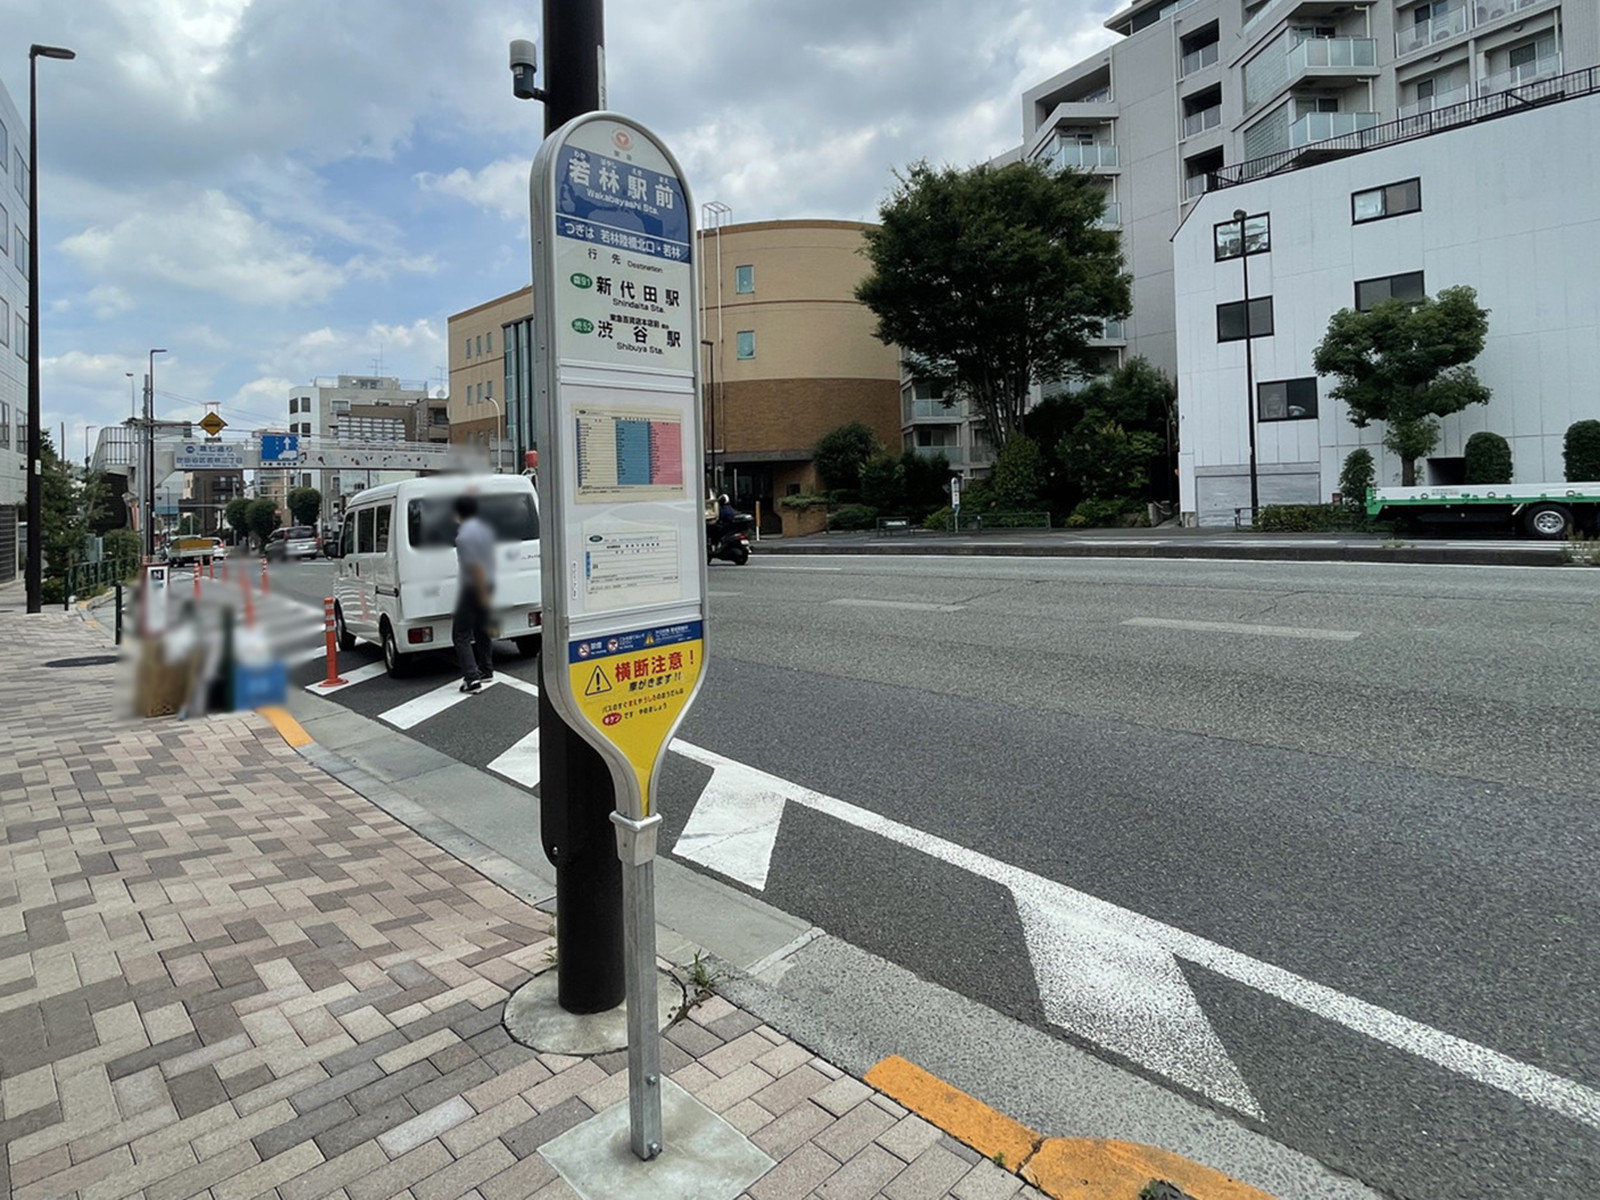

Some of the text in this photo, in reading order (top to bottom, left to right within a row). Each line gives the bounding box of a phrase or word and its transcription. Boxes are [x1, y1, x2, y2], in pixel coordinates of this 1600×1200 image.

[569, 158, 674, 209] 若林駅前
[586, 188, 659, 215] Wakabayashi Sta.
[564, 222, 595, 239] つぎは
[627, 260, 663, 274] Destination
[596, 275, 680, 307] 新代田駅
[612, 298, 666, 314] Shindaita Sta.
[598, 320, 681, 348] 渋谷駅
[616, 342, 665, 355] Shibuya Sta.
